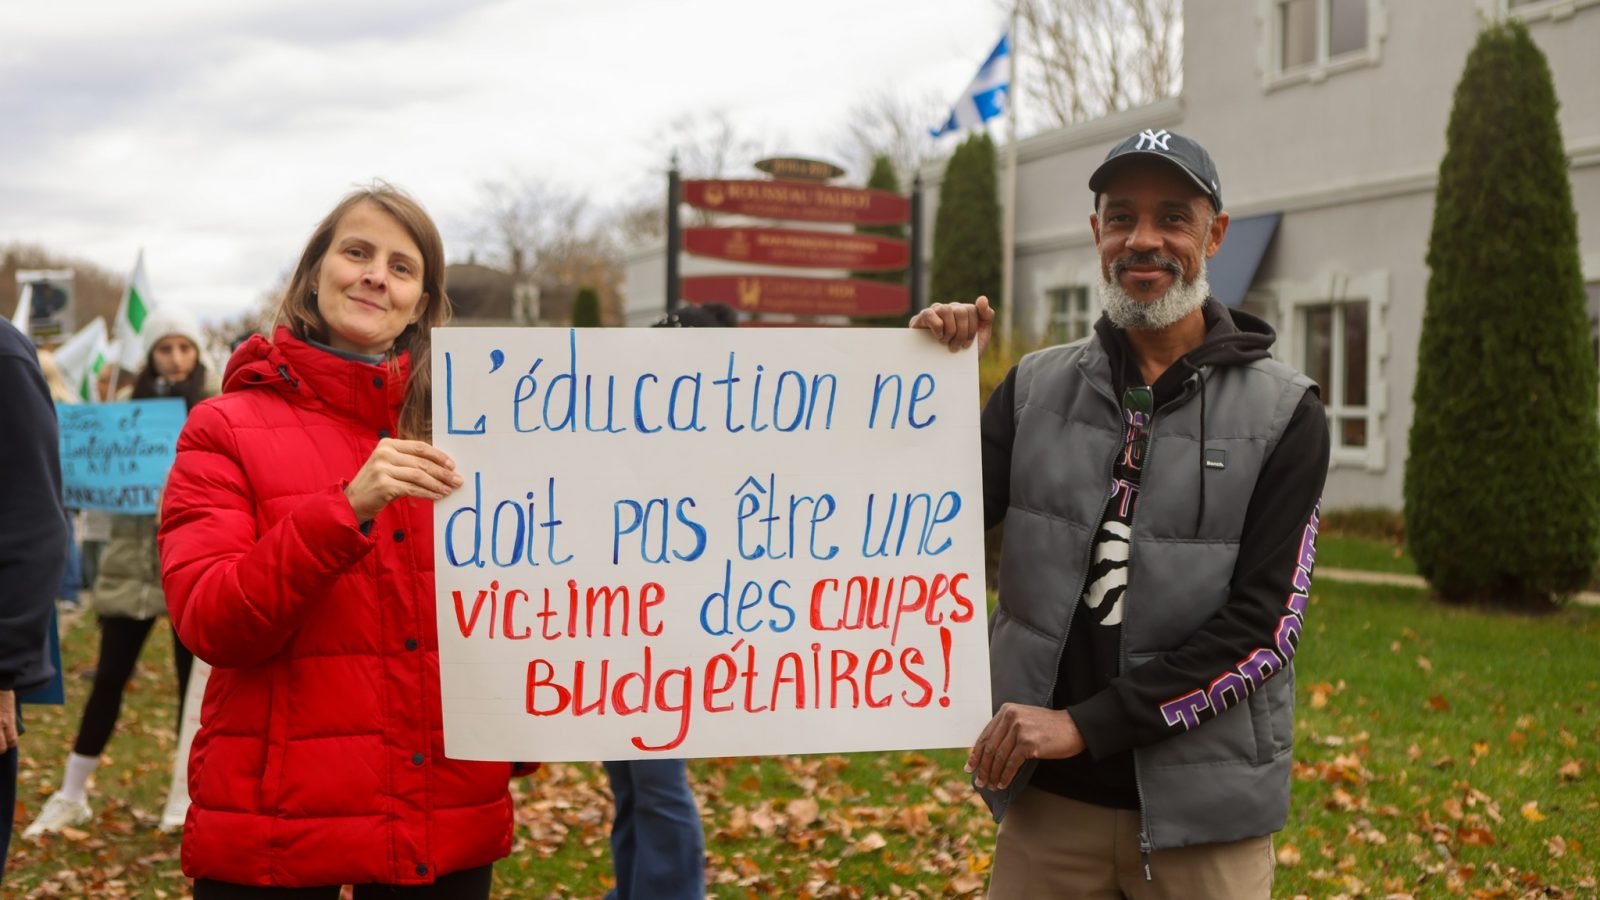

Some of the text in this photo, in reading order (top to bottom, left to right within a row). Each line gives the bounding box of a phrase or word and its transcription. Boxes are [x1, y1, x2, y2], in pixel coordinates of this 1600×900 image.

[1135, 129, 1171, 151] NY
[446, 329, 936, 435] L'éducation ne
[445, 472, 962, 568] doit pas être une
[452, 559, 975, 646] victime des coupes
